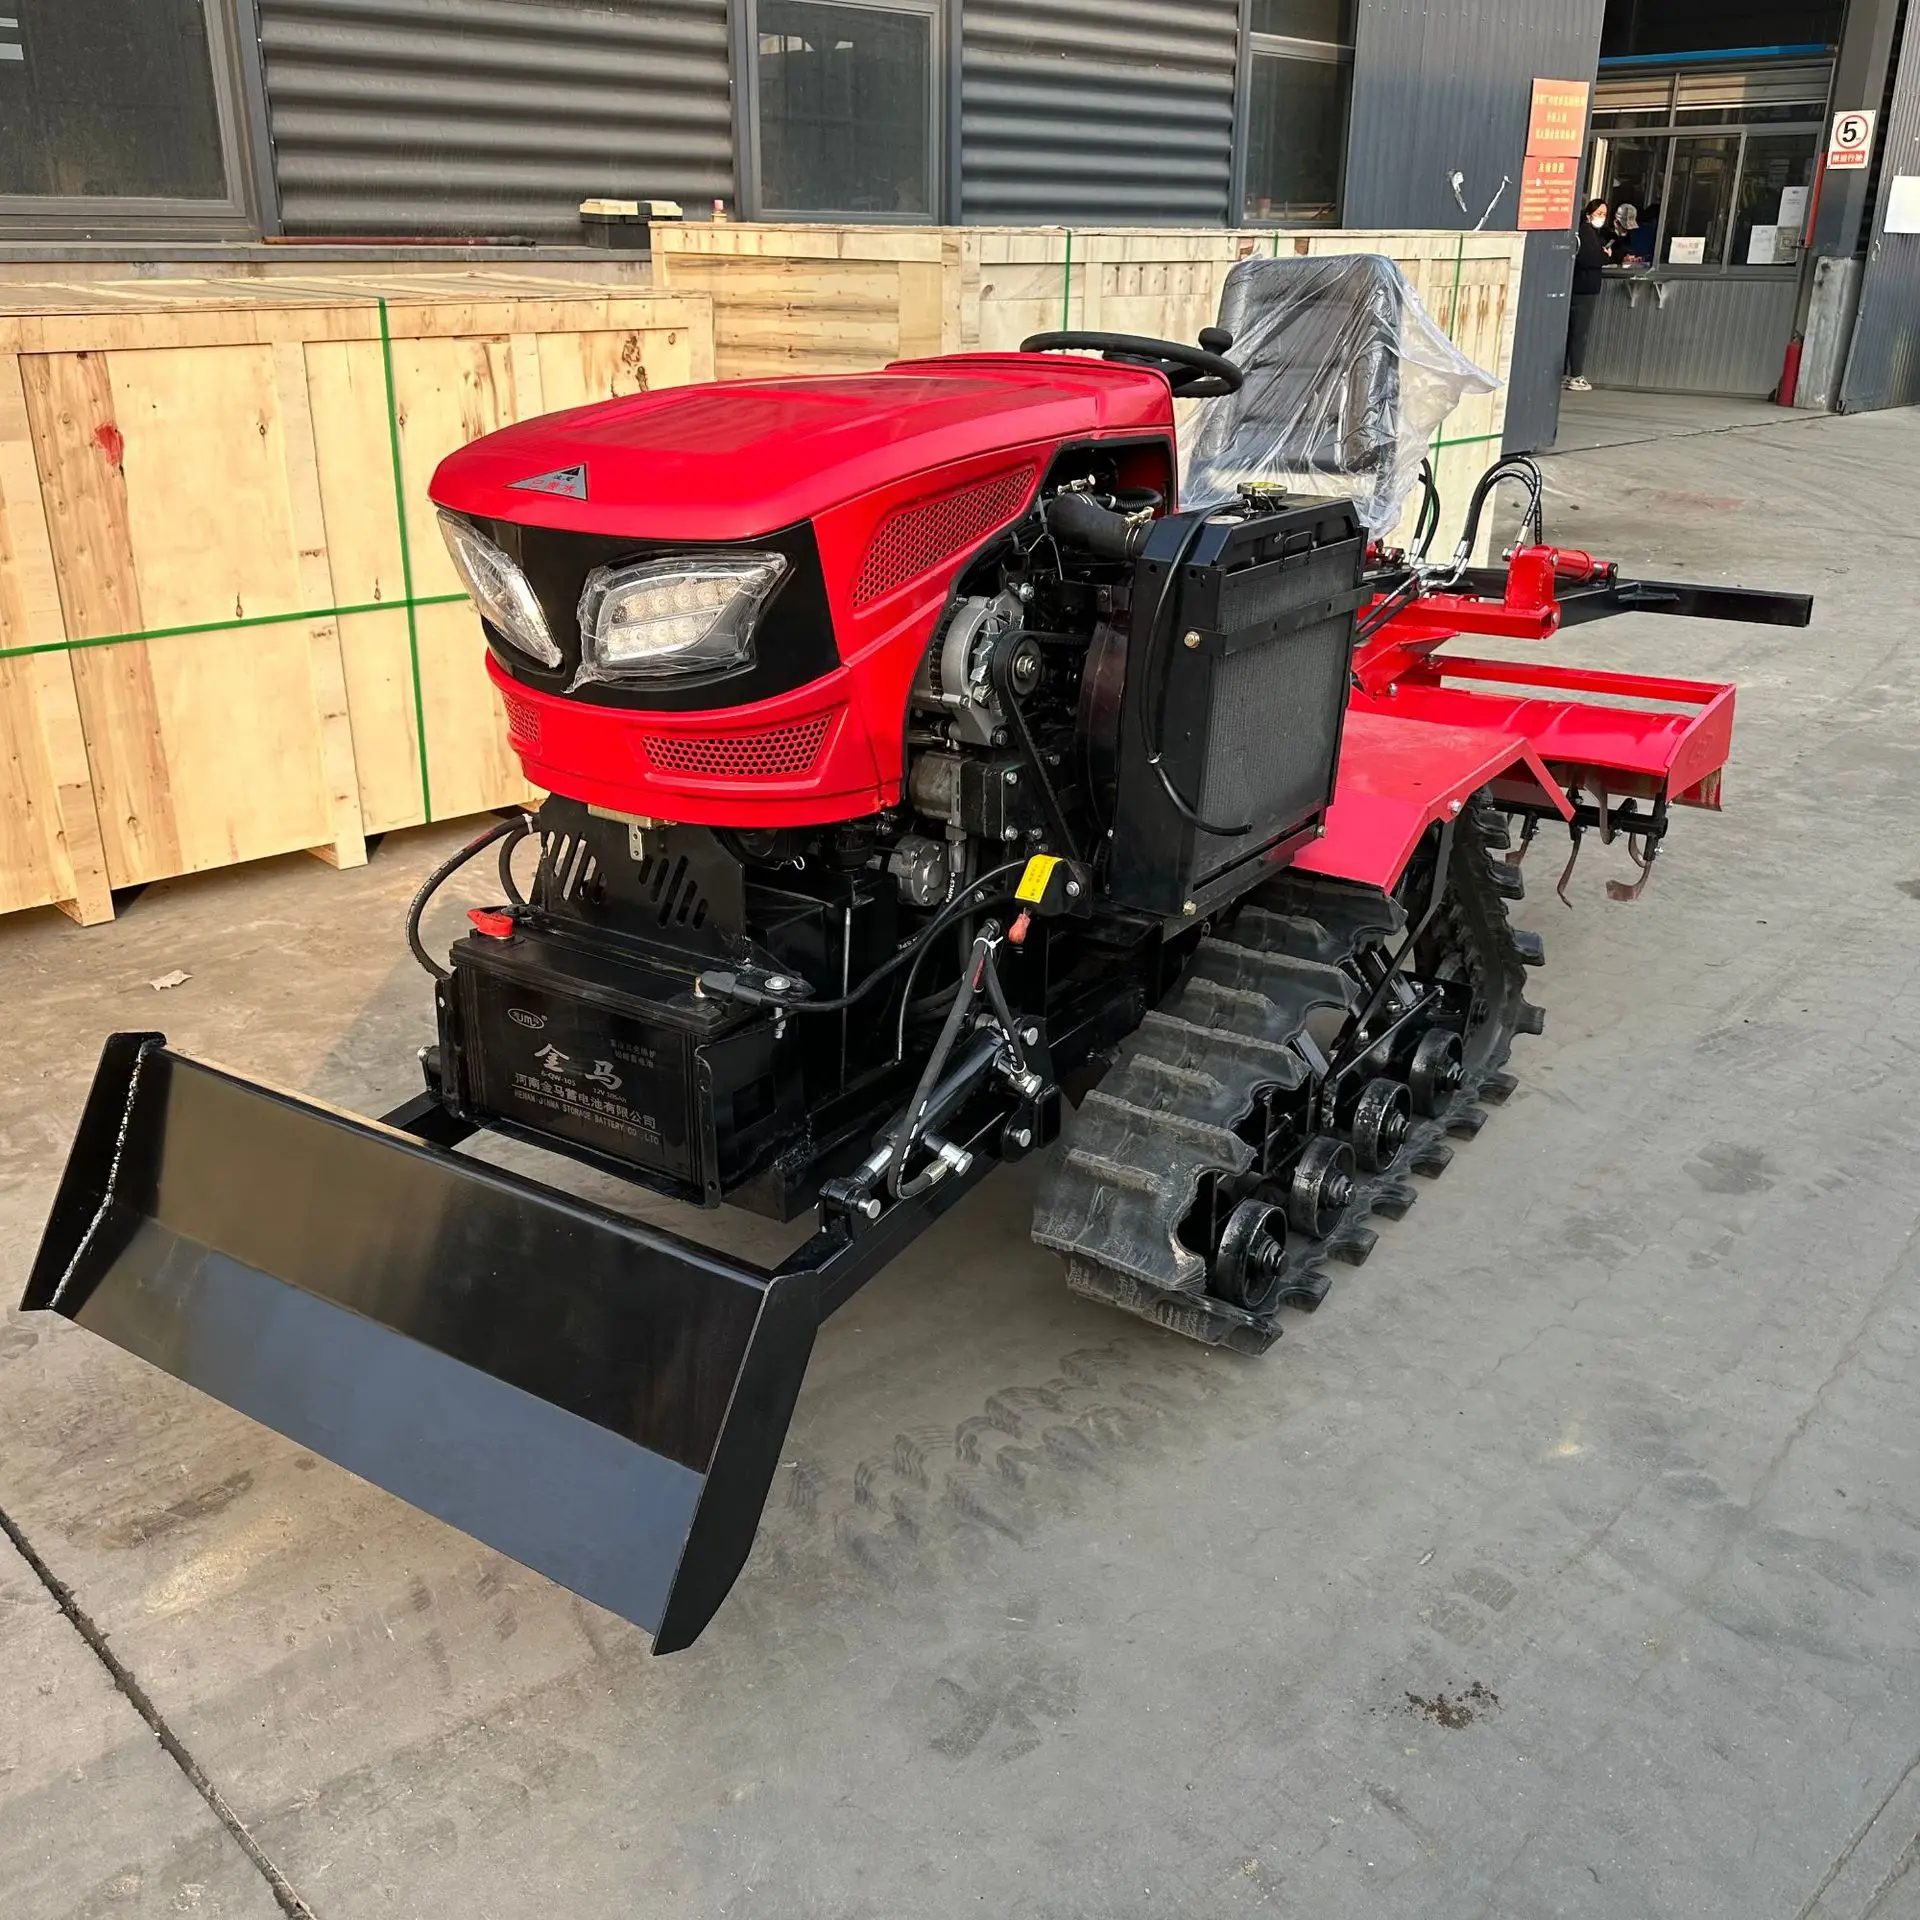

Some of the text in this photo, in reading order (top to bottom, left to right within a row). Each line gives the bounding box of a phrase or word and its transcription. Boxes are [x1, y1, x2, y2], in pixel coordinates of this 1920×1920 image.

[1842, 121, 1858, 143] 5
[515, 1072, 656, 1129] 河南金马蓄电池有限公司
[594, 1114, 625, 1131] BATTERY
